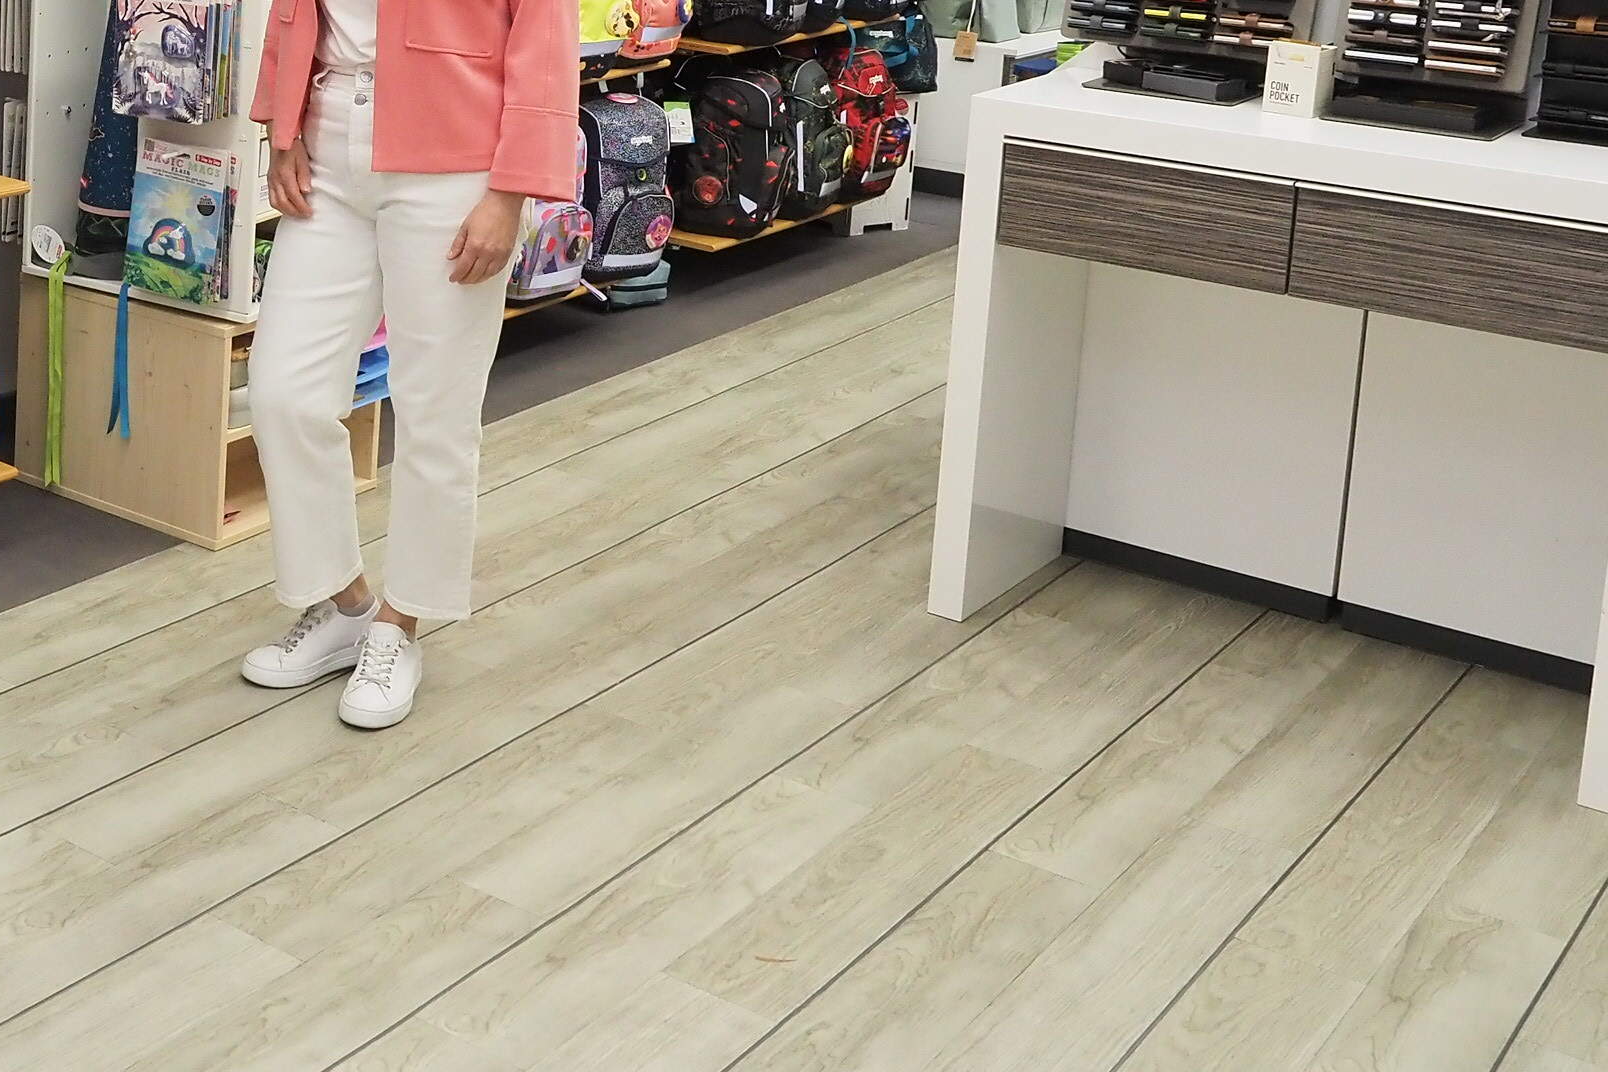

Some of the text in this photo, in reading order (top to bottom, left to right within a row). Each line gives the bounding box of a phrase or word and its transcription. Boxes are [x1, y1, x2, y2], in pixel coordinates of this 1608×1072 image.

[1270, 80, 1289, 92] COIN
[1269, 90, 1300, 104] POCKET
[142, 151, 183, 168] MAGIC
[187, 161, 220, 177] MAGS
[172, 167, 192, 177] FLAIR
